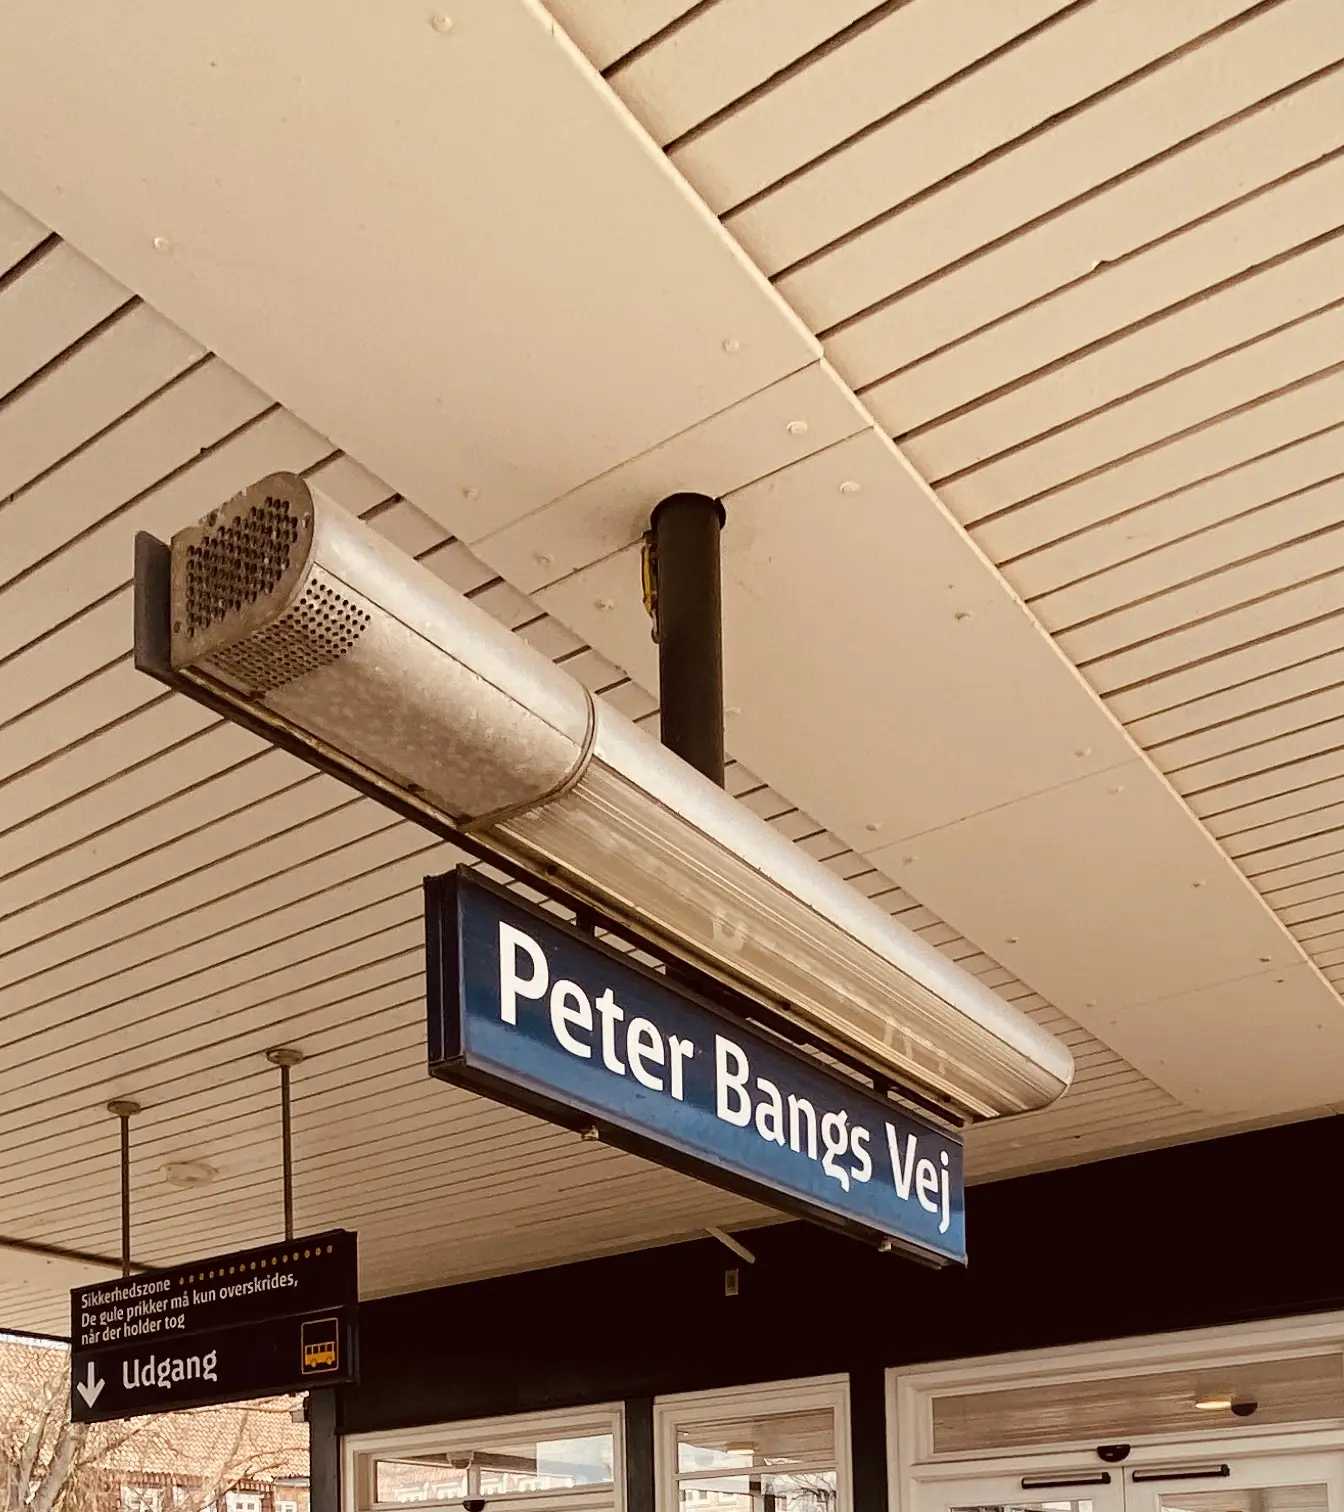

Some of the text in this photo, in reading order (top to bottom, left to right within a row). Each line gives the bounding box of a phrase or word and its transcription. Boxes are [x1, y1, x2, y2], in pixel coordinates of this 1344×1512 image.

[498, 920, 951, 1235] Peter Bangs Vej
[81, 1279, 171, 1309] Sikkerhedszone
[81, 1272, 299, 1328] De gule prikker må kun overskrides,
[81, 1313, 186, 1346] når der holder tog
[122, 1349, 218, 1390] Udgang
